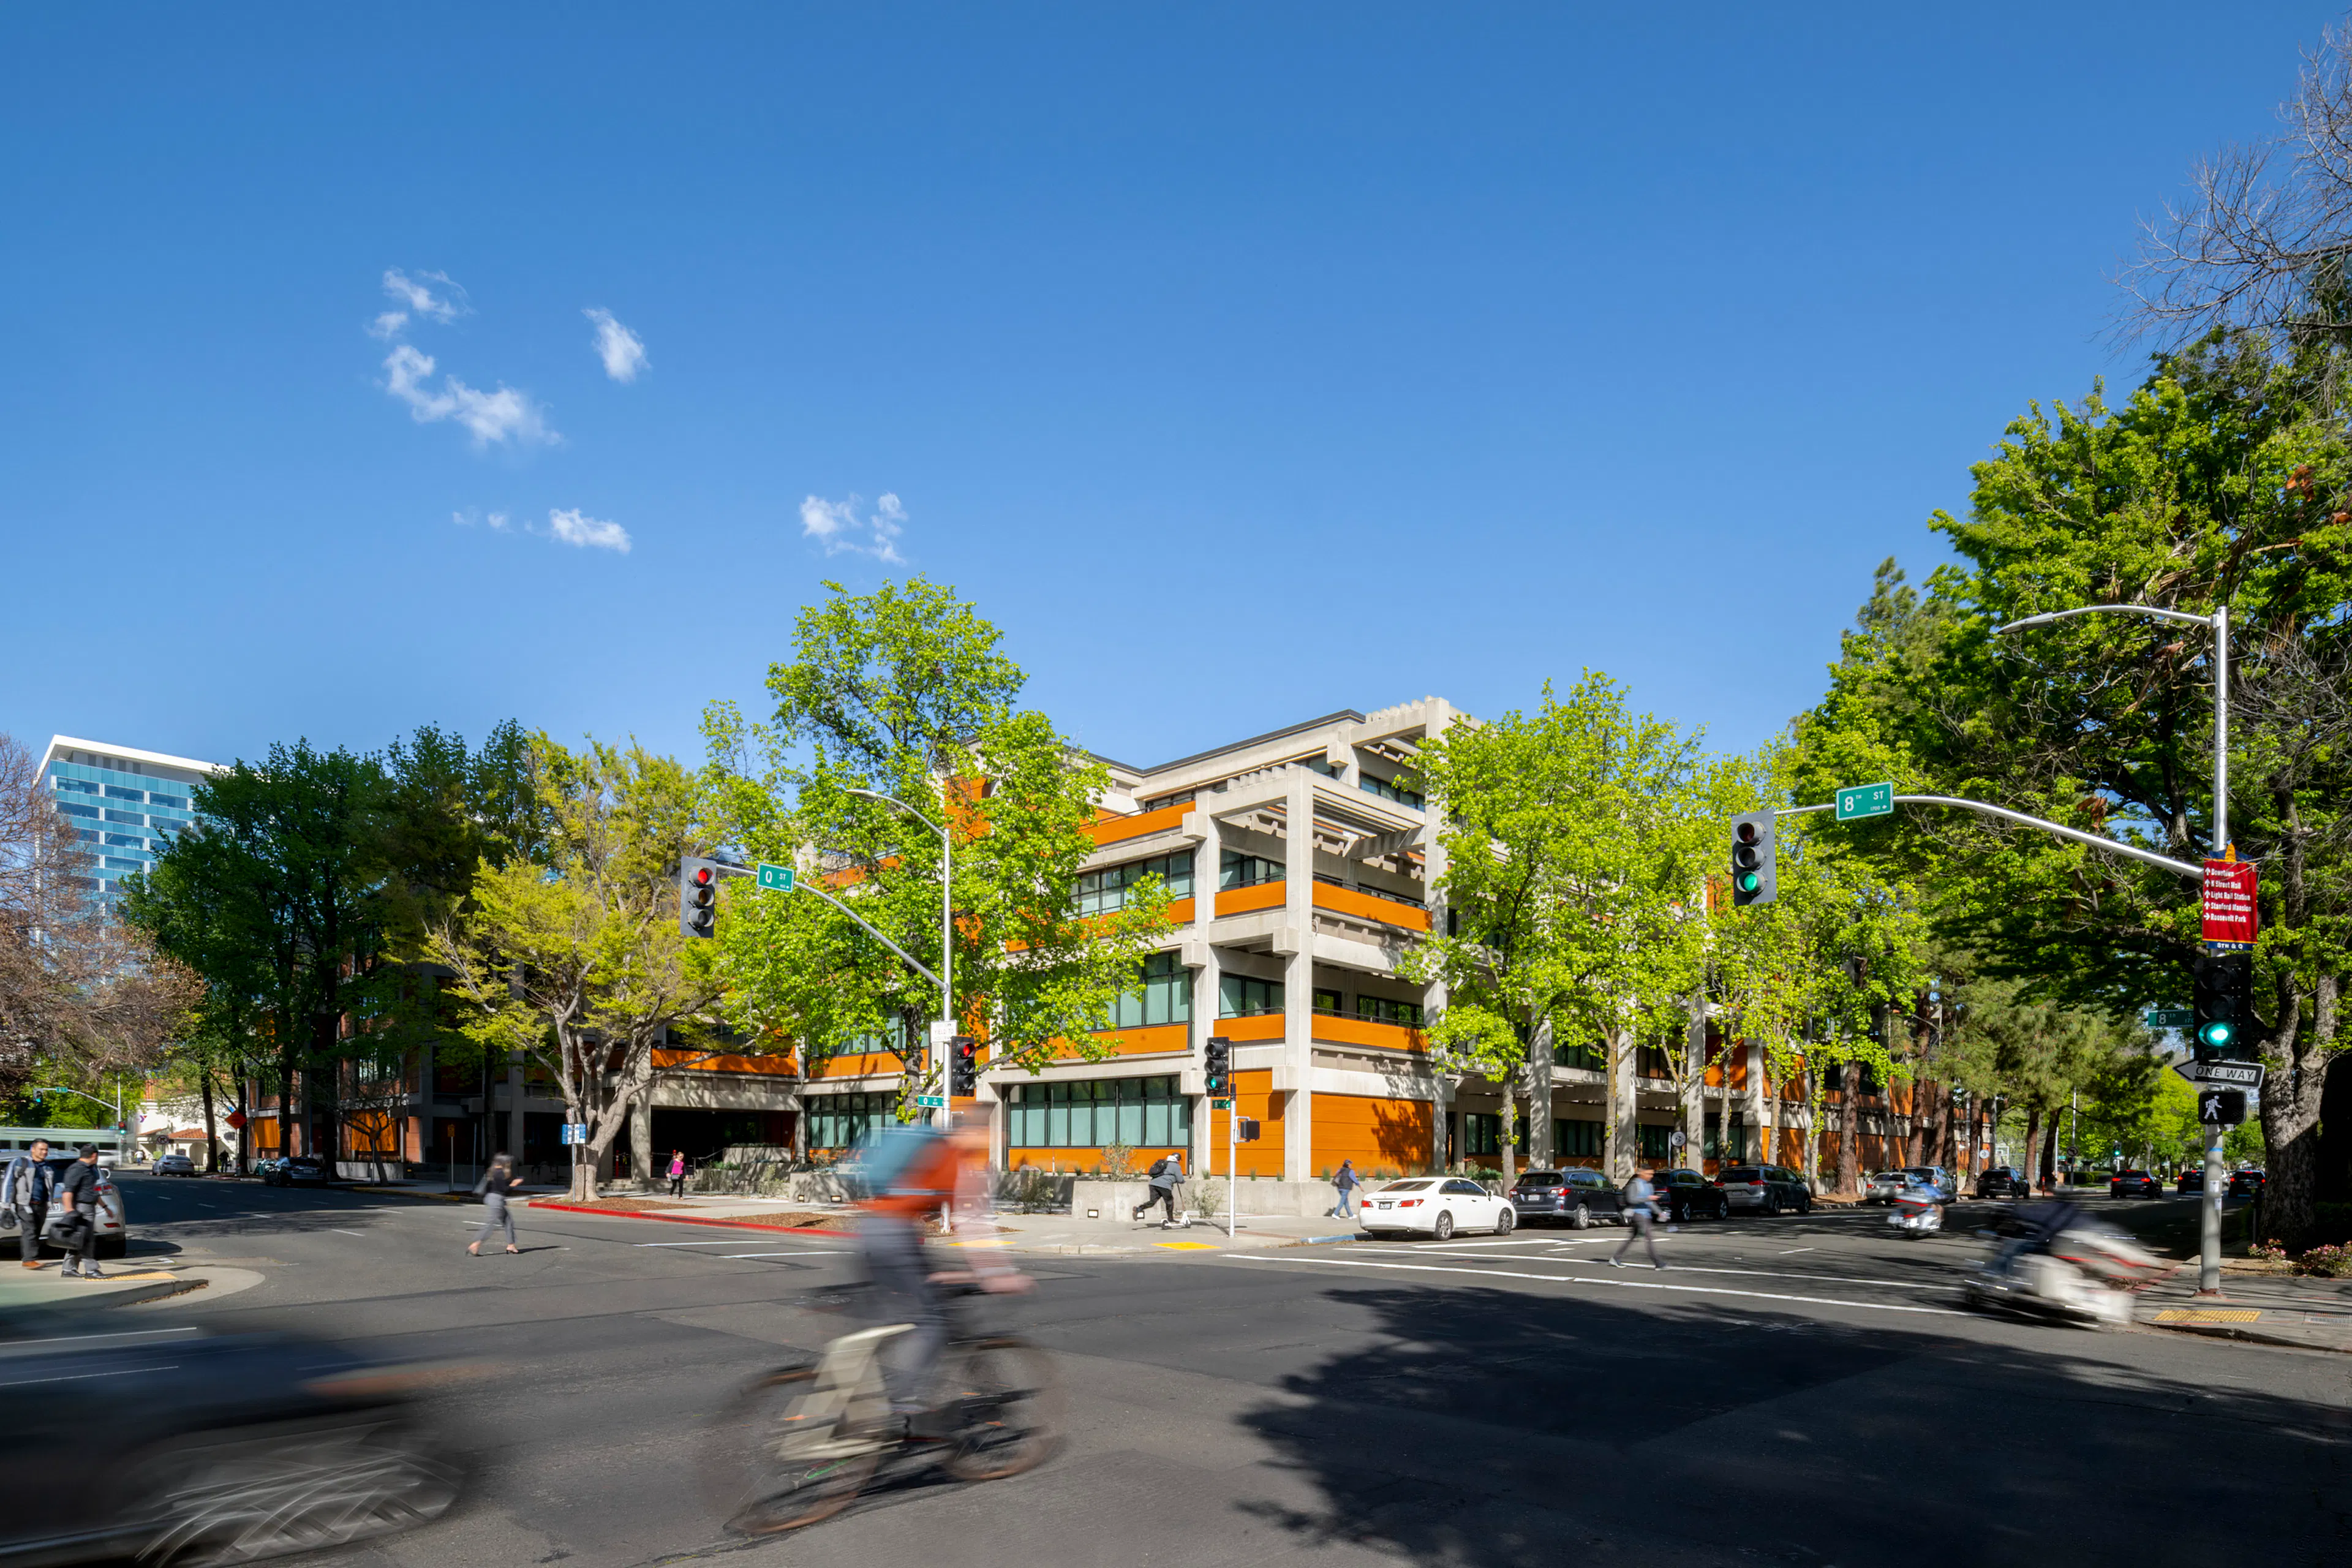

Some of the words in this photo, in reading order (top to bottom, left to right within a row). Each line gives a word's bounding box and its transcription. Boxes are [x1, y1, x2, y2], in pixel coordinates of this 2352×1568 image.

[1873, 791, 1884, 800] ST
[2211, 868, 2234, 877] Downtown
[2211, 891, 2223, 900] Light
[2211, 902, 2231, 911] Stanford
[2232, 903, 2252, 912] Mansion
[2211, 913, 2234, 922] Roosevelt
[2196, 1066, 2221, 1077] ONE
[2226, 1069, 2254, 1080] WAY
